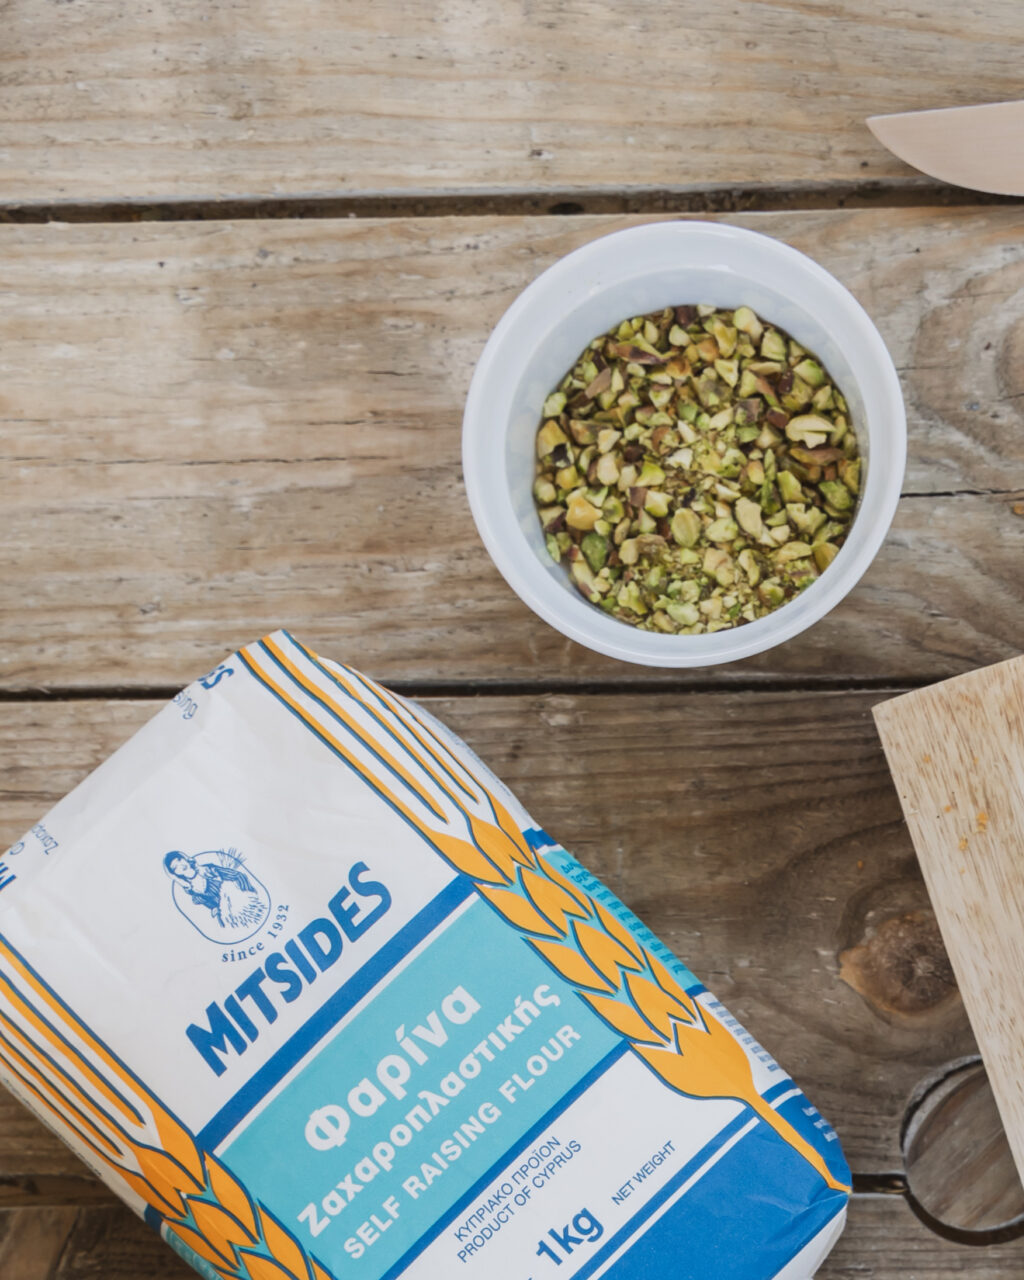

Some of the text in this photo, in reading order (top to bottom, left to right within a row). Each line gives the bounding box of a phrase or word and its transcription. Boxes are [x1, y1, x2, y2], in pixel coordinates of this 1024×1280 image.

[185, 860, 392, 1078] MITSIDES
[221, 903, 290, 963] since 1932
[296, 983, 562, 1238] Ζαχαροπλαστικής
[304, 984, 482, 1151] Φαρίνα
[343, 1024, 582, 1260] SELF RAISING FLOUR
[457, 1140, 582, 1264] PRODUCT OF CYPRUS
[610, 1140, 676, 1206] NET WEIGHT
[535, 1207, 605, 1267] 1kg
